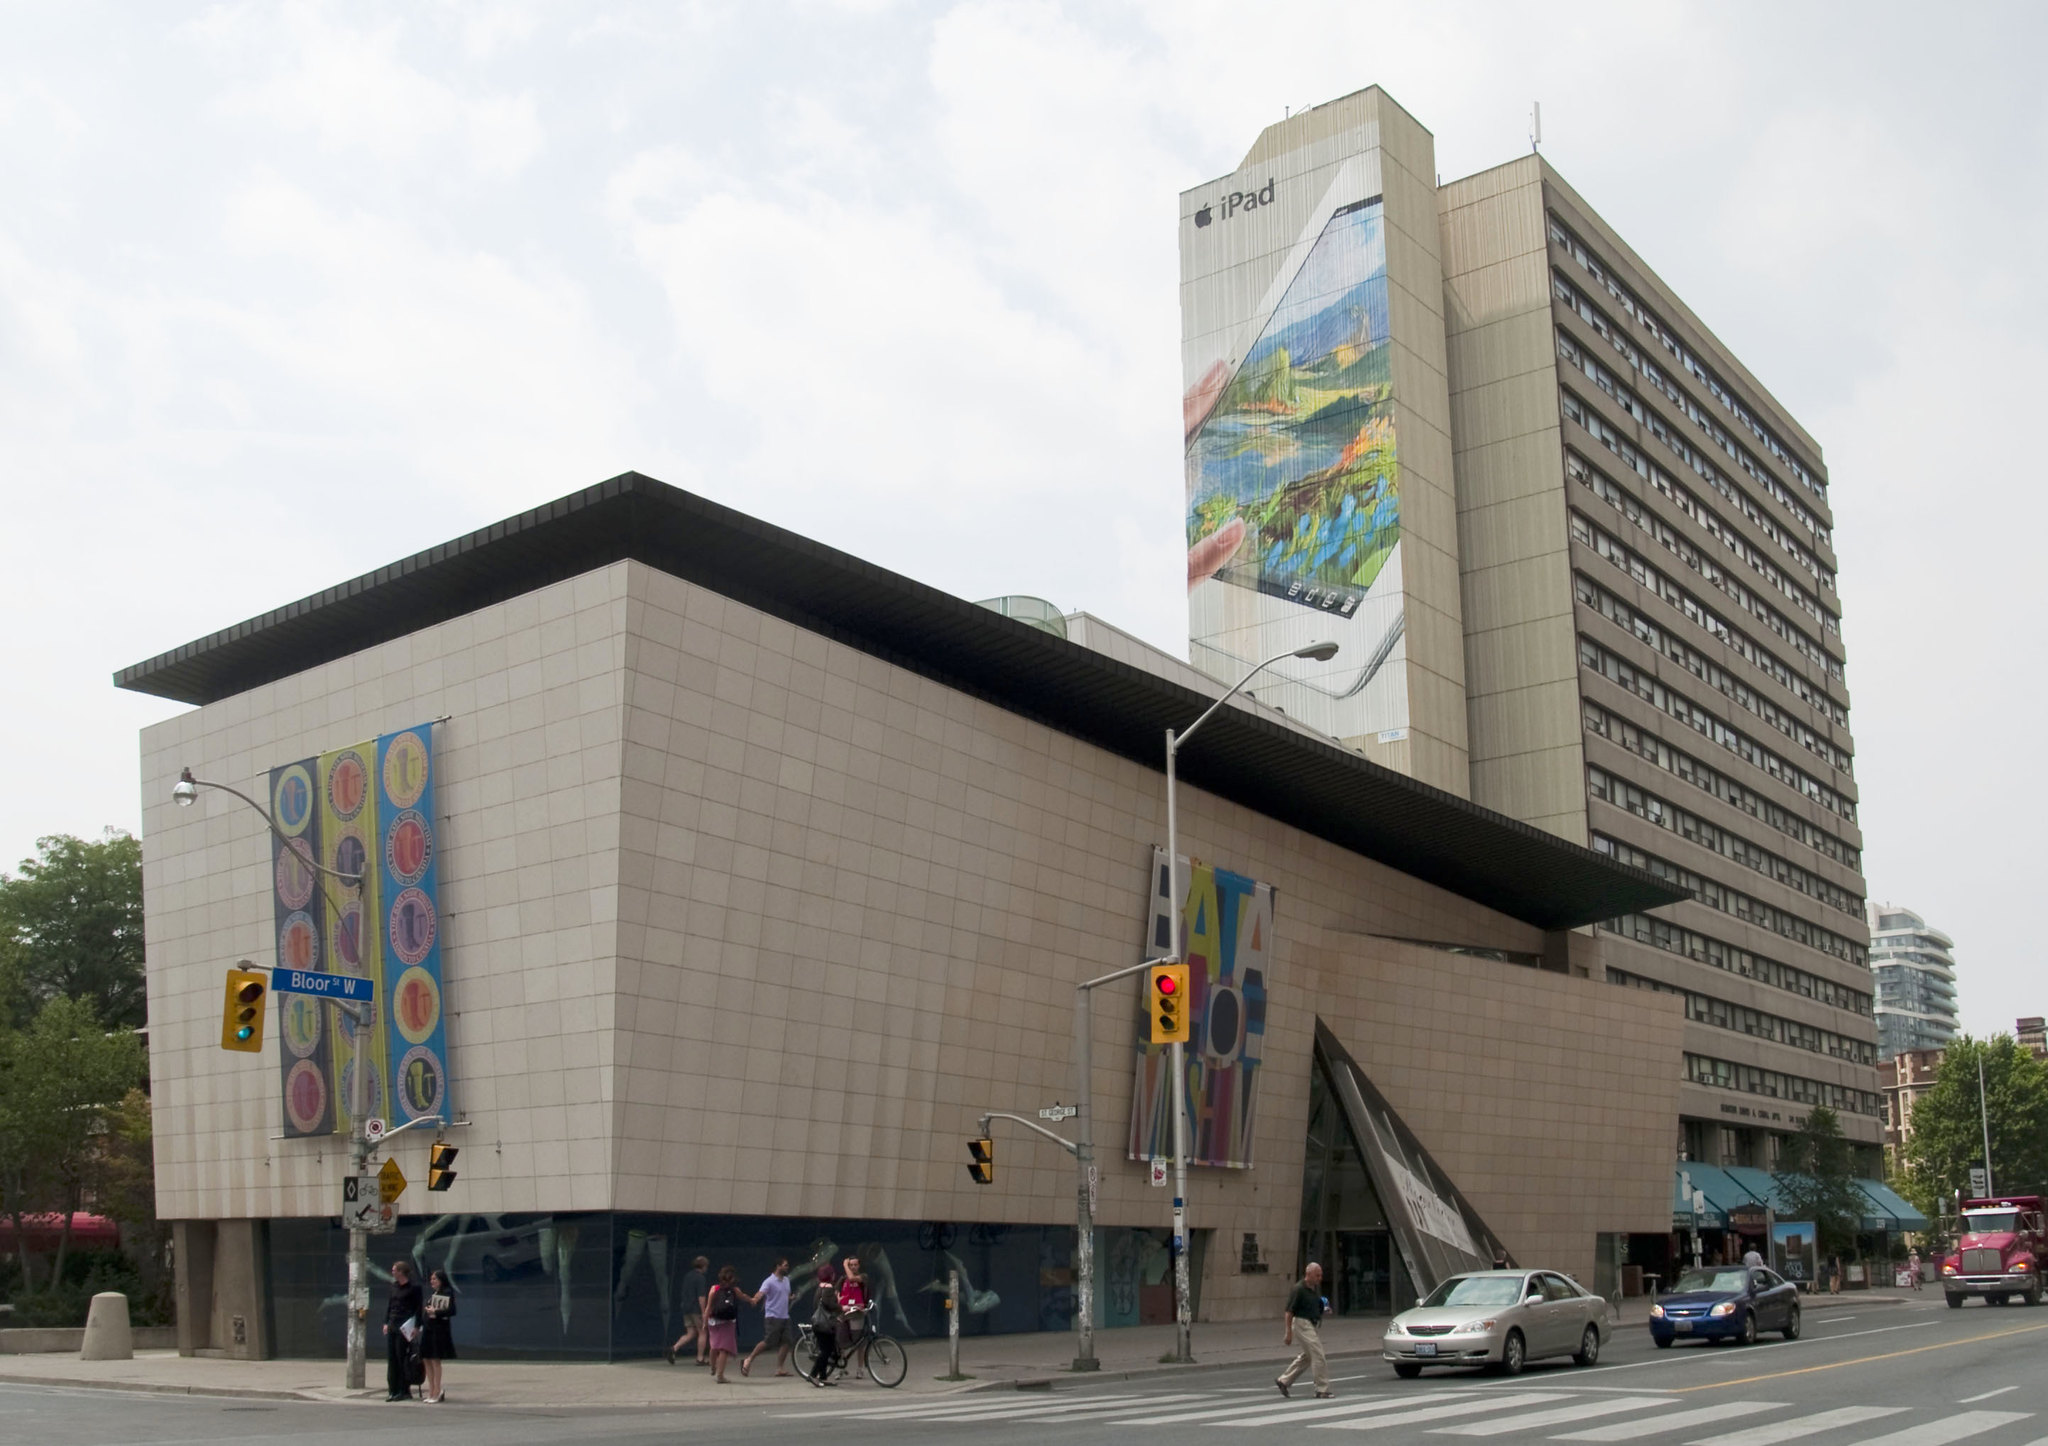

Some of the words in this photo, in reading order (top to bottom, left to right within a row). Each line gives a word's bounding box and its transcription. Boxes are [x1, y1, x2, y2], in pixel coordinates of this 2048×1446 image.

[1221, 177, 1275, 220] iPad
[1381, 731, 1400, 739] TITAN
[291, 972, 330, 991] Bloor
[332, 978, 340, 986] St
[343, 979, 356, 995] W
